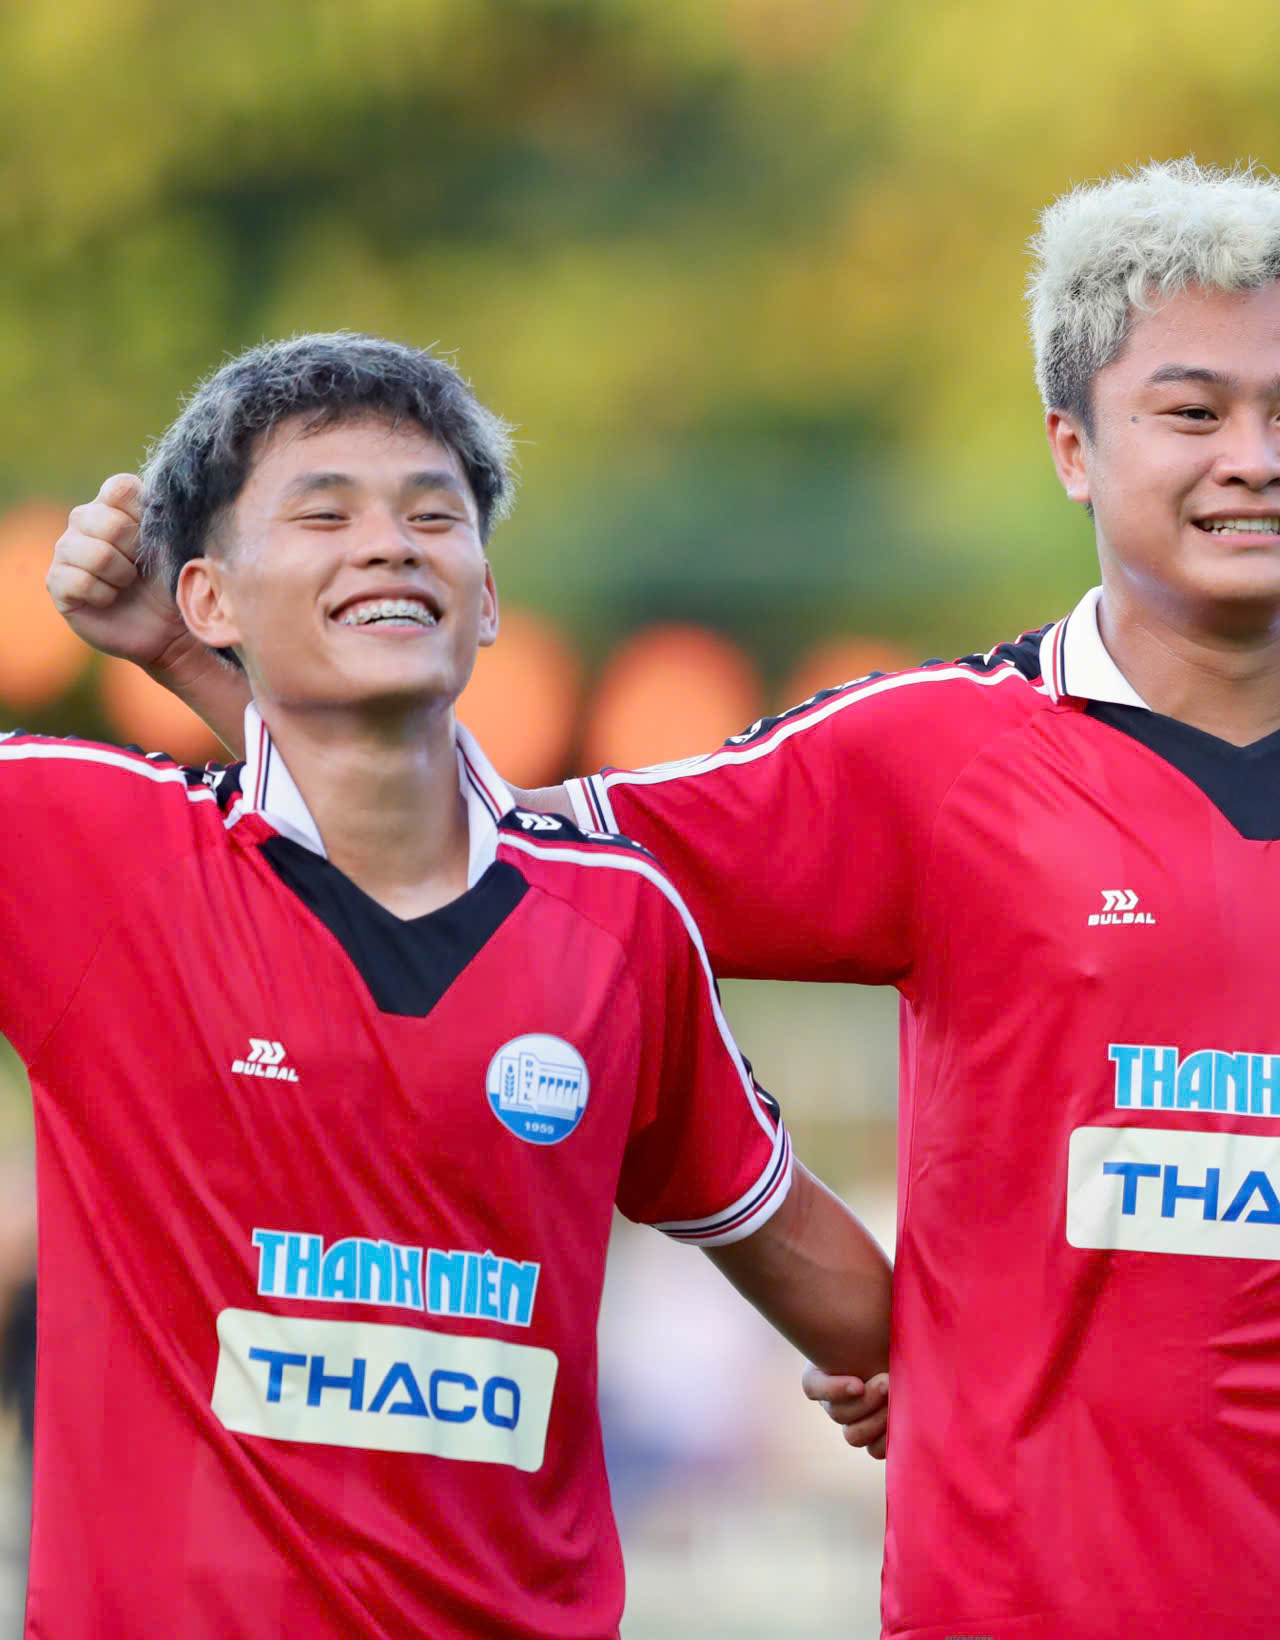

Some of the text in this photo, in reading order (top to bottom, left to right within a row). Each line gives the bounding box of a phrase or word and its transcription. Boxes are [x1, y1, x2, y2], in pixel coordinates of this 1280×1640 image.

[1087, 912, 1157, 926] BULBAL
[231, 1059, 300, 1083] BULBAL
[525, 1121, 555, 1134] 1959
[252, 1227, 541, 1328] THANH NIÊN
[248, 1346, 522, 1431] THACO
